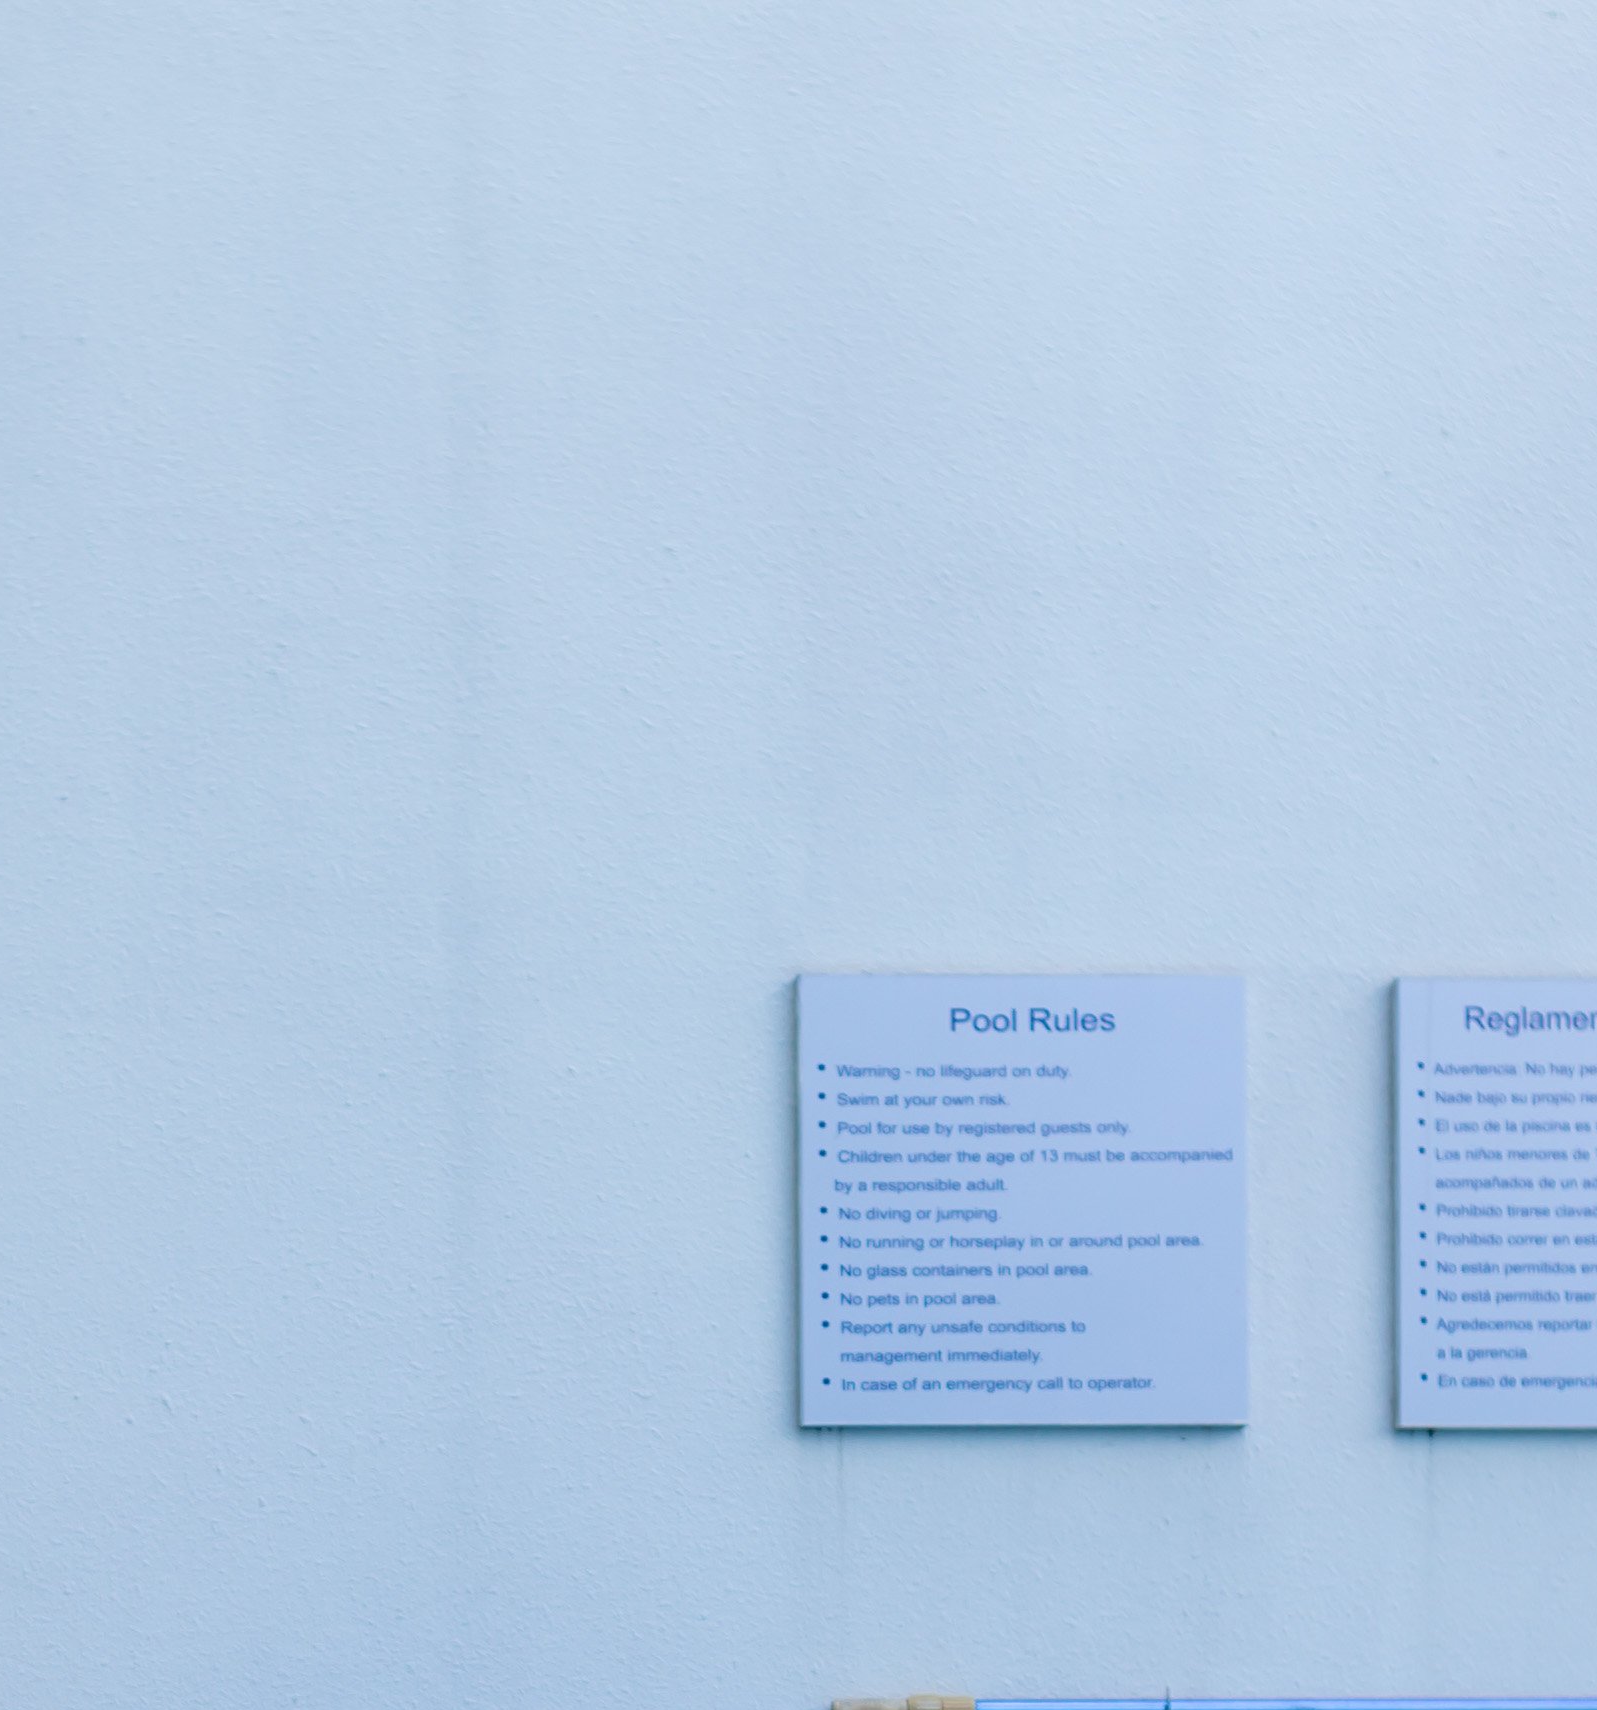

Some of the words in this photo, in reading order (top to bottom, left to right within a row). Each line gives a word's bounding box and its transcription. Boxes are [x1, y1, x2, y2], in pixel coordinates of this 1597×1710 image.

[950, 1008, 1017, 1033] Pool
[1029, 1008, 1116, 1033] Rules
[836, 1064, 901, 1081] Warning
[915, 1067, 936, 1078] no
[940, 1064, 1007, 1081] lifeguard
[1012, 1067, 1031, 1078] on
[836, 1092, 879, 1107] Swim
[884, 1094, 899, 1107] at
[903, 1096, 937, 1109] your
[941, 1096, 975, 1106] own
[836, 1120, 872, 1136] Pool
[876, 1121, 897, 1135] for
[901, 1124, 930, 1136] use
[934, 1122, 953, 1138] by
[957, 1121, 1036, 1138] registered
[1040, 1122, 1092, 1137] guests
[836, 1149, 903, 1165] Children
[906, 1150, 952, 1164] under
[956, 1150, 981, 1163] the
[985, 1152, 1015, 1166] age
[1019, 1150, 1035, 1163] of
[1041, 1149, 1059, 1163] 13
[1063, 1151, 1101, 1162] must
[1106, 1150, 1125, 1162] be
[1130, 1149, 1233, 1163] accompanied
[833, 1179, 853, 1195] by
[857, 1181, 868, 1192] a
[871, 1179, 961, 1194] responsible
[837, 1207, 862, 1221] No
[865, 1207, 912, 1224] diving
[915, 1209, 931, 1220] or
[838, 1235, 862, 1249] No
[865, 1236, 925, 1252] running
[929, 1238, 945, 1248] or
[949, 1235, 1025, 1251] horseplay
[1030, 1236, 1044, 1247] in
[1048, 1237, 1063, 1248] or
[1069, 1234, 1123, 1248] around
[1127, 1234, 1160, 1249] pool
[1166, 1236, 1204, 1247] area.
[839, 1264, 862, 1278] No
[866, 1264, 907, 1280] glass
[911, 1264, 993, 1277] containers
[997, 1264, 1011, 1276] in
[1016, 1263, 1049, 1279] pool
[1054, 1265, 1093, 1276] area.
[840, 1293, 863, 1306] No
[867, 1294, 900, 1308] pets
[905, 1295, 919, 1305] in
[923, 1293, 957, 1308] pool
[961, 1295, 1000, 1305] area.
[840, 1320, 893, 1337] Report
[897, 1323, 926, 1337] any
[931, 1320, 983, 1334] unsafe
[988, 1320, 1066, 1334] conditions
[1071, 1321, 1086, 1333] to
[840, 1350, 943, 1366] management
[841, 1379, 856, 1391] In
[860, 1380, 898, 1392] case
[901, 1377, 918, 1391] of
[921, 1380, 942, 1392] an
[945, 1380, 1033, 1393] emergency
[1037, 1377, 1063, 1390] call
[1068, 1378, 1083, 1390] to
